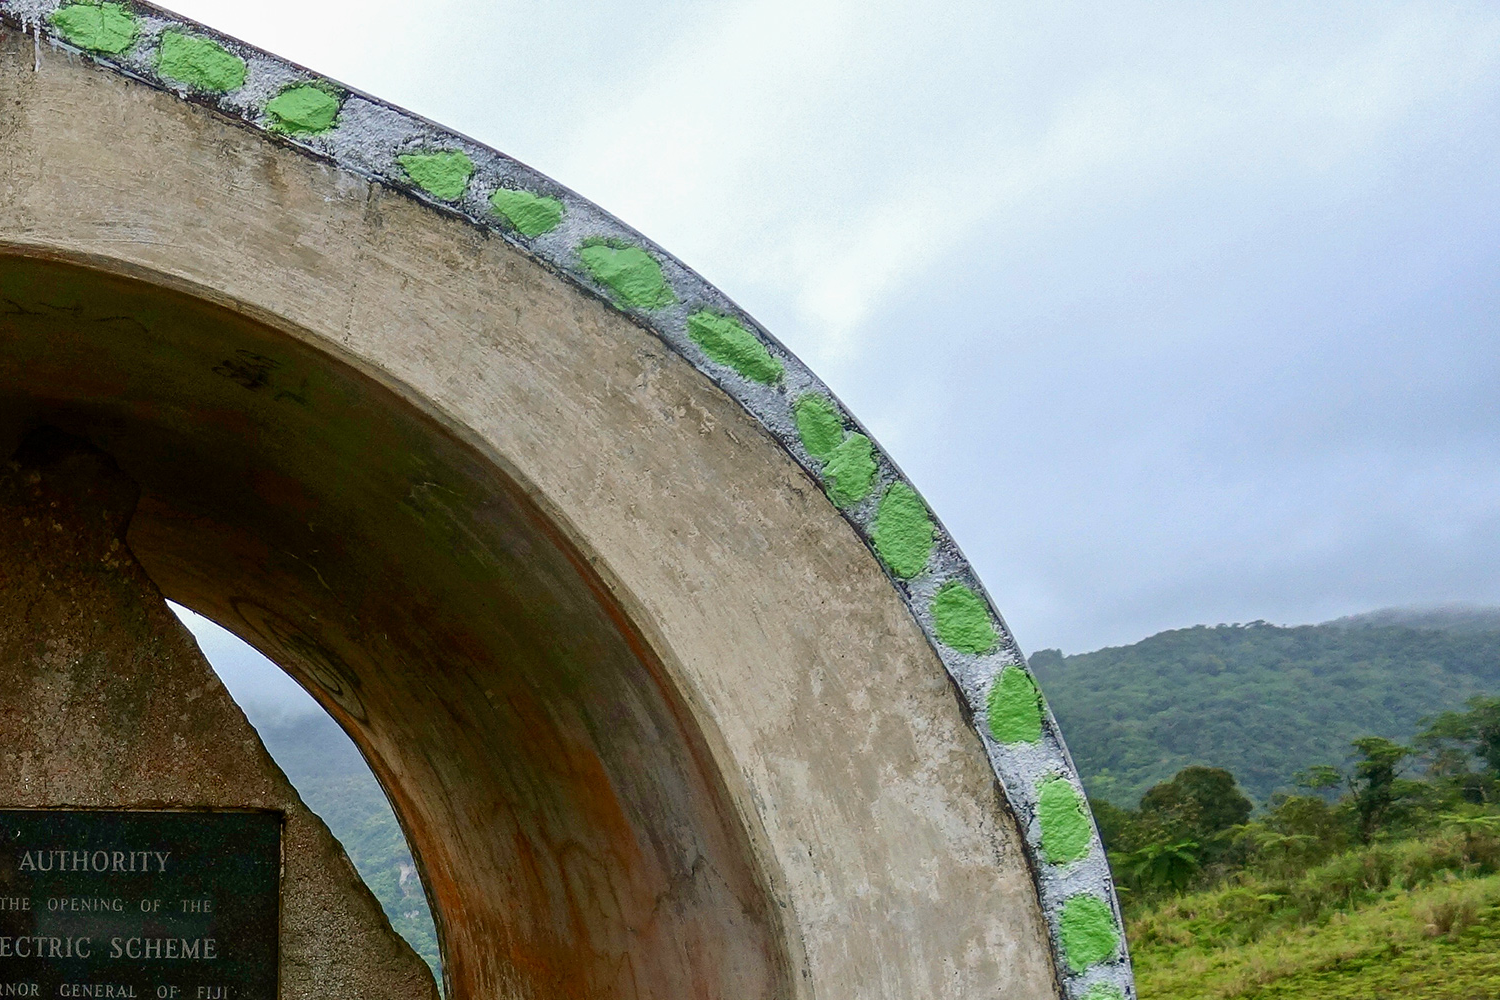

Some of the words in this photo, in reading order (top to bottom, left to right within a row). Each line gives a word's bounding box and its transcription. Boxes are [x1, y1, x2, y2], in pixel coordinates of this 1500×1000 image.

[18, 850, 171, 872] AUTHORITY
[47, 897, 124, 912] OPENING
[140, 898, 162, 912] OF
[182, 899, 213, 913] THE
[109, 937, 218, 960] SCHEME
[60, 983, 138, 998] GENERAL
[157, 984, 178, 999] OF
[197, 985, 230, 1000] FIJI
